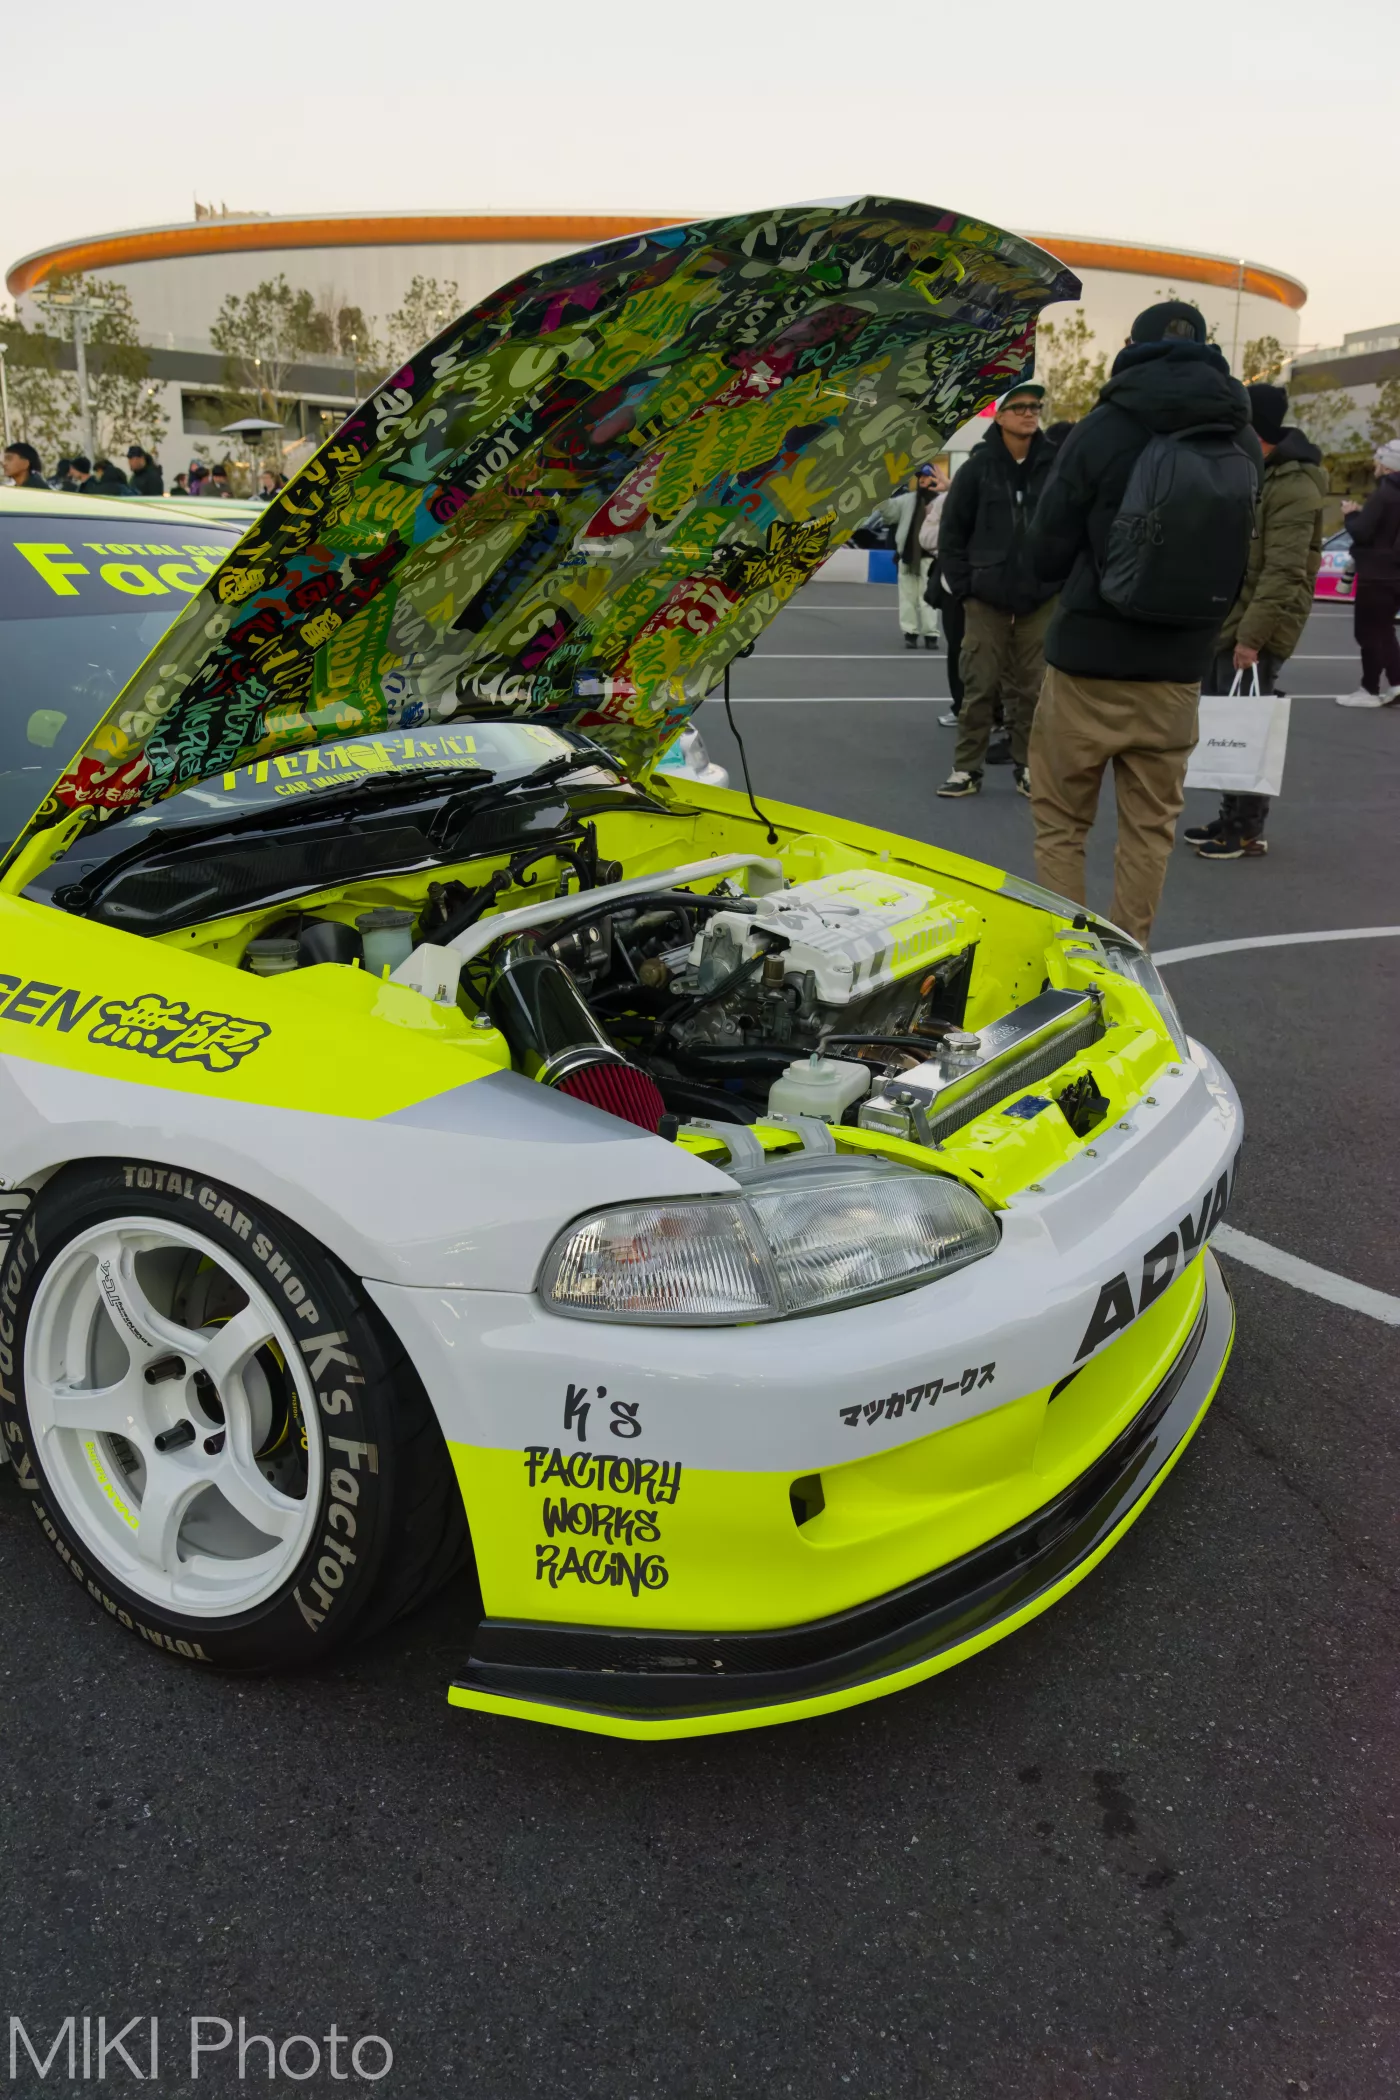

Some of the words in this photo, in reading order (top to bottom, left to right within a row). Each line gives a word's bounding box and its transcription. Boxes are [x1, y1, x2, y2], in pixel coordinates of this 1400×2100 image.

[82, 543, 186, 556] TOTAL
[274, 781, 313, 796] CAR
[88, 993, 272, 1073] 無限
[122, 1165, 196, 1200] TOTAL
[198, 1186, 253, 1241] CAR
[251, 1233, 320, 1324] SHOP
[564, 1384, 642, 1442] K's
[839, 1362, 996, 1427] マツカワワークス
[524, 1446, 682, 1504] FACTORY
[103, 1484, 139, 1530] DVAN
[292, 1436, 379, 1632] Factory
[543, 1497, 661, 1546] WORKS
[136, 1621, 214, 1662] TOTAL
